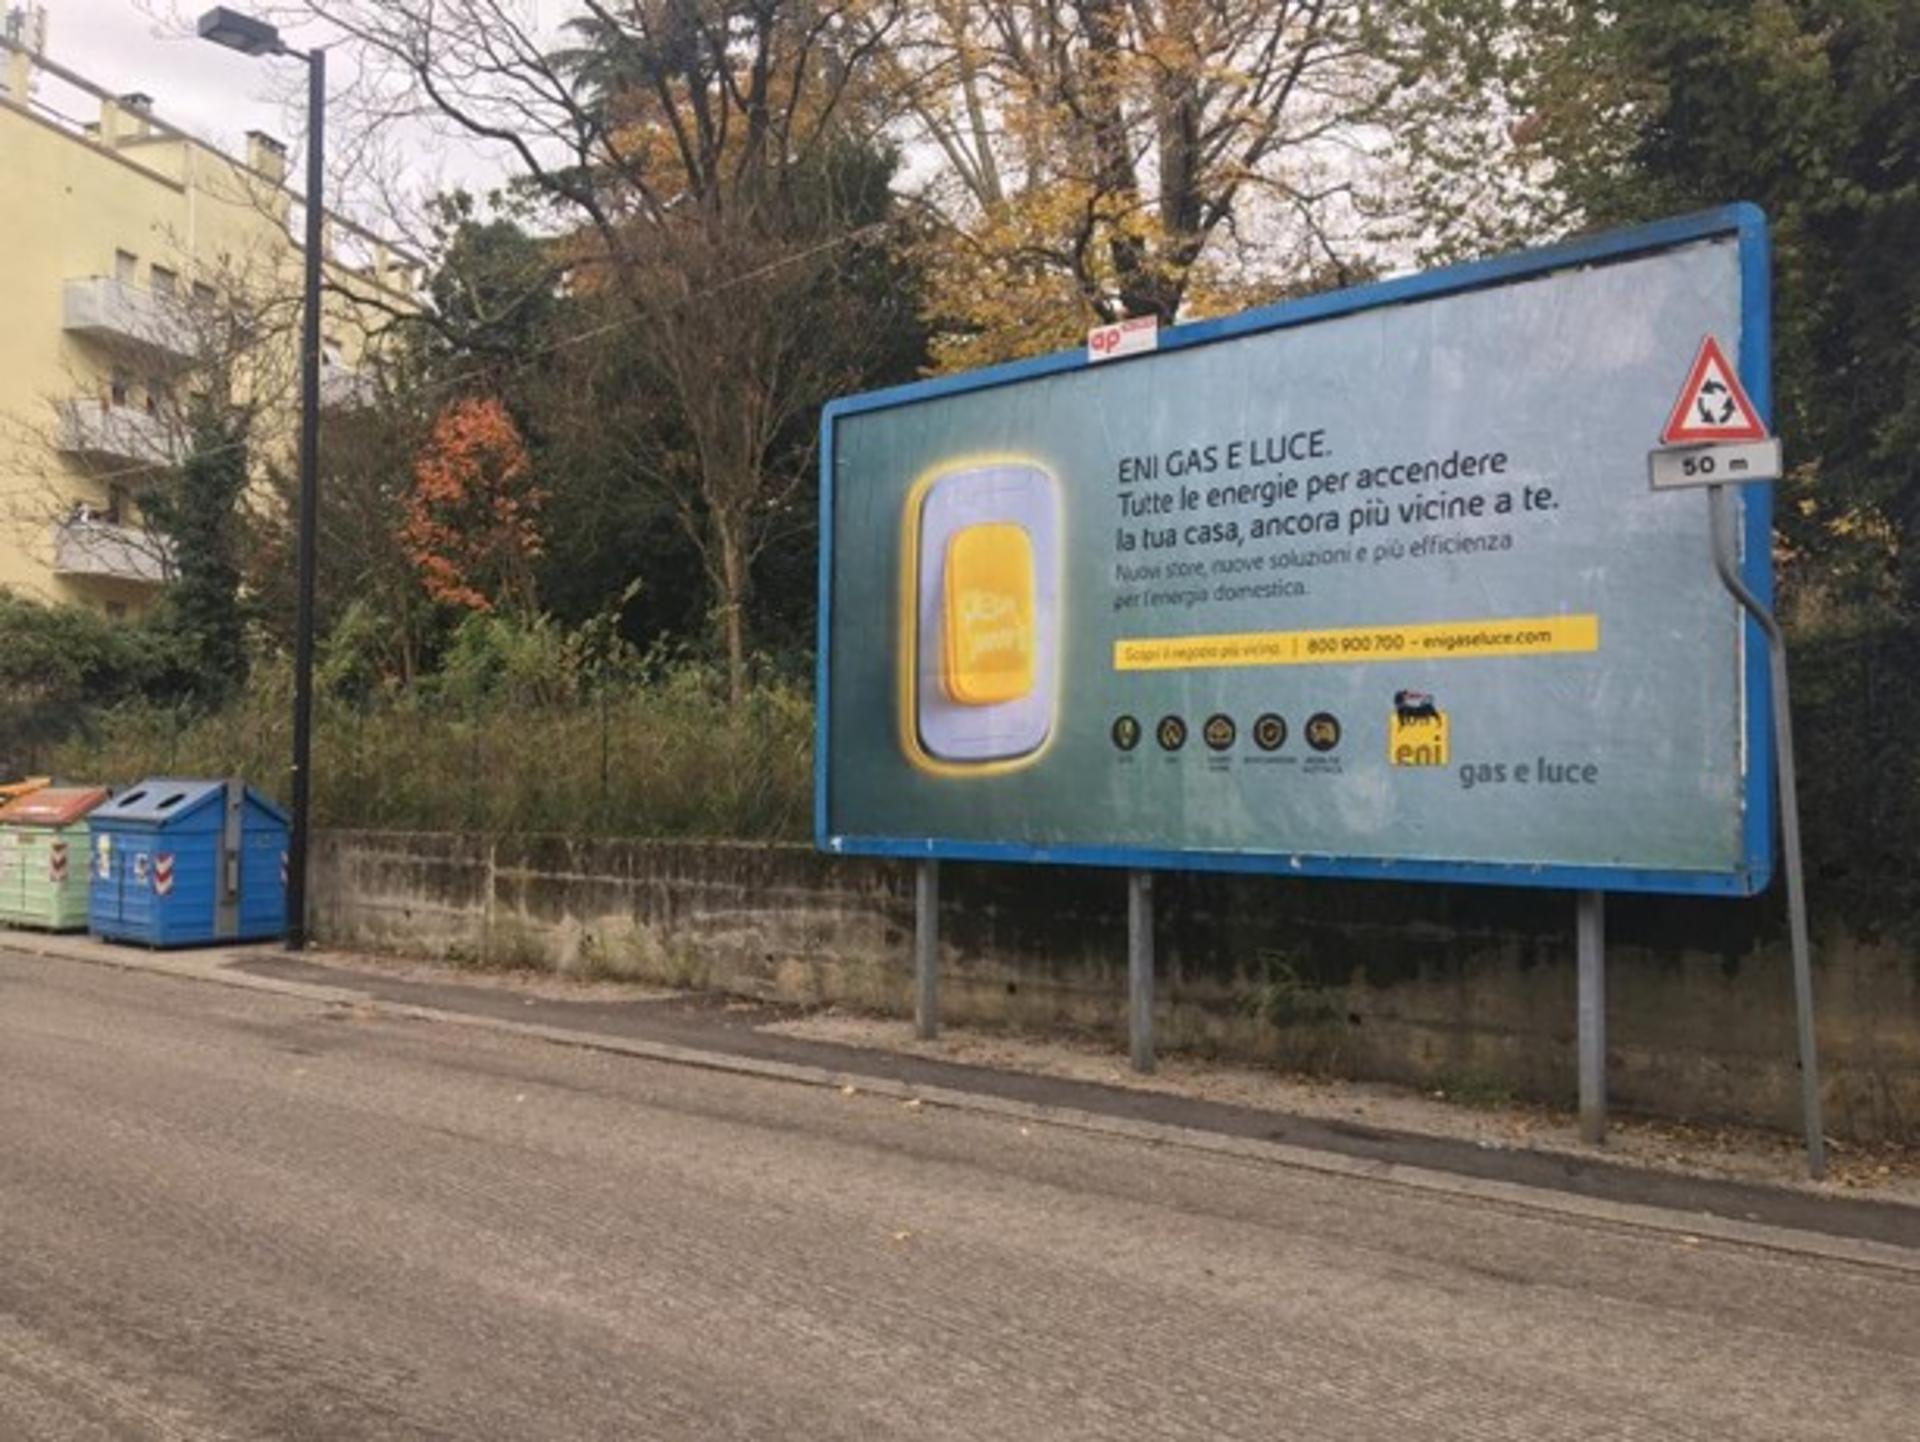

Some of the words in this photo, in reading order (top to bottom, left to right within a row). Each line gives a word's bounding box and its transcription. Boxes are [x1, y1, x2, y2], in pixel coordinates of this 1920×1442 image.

[1118, 455, 1158, 483] ENI
[1165, 446, 1219, 477] GAS
[1227, 441, 1243, 469] E
[1250, 429, 1333, 466] LUCE.
[1682, 456, 1715, 476] 50
[1117, 491, 1173, 517] Tutte
[1180, 485, 1199, 511] le
[1206, 471, 1298, 507] energie
[1306, 472, 1350, 501] per
[1356, 450, 1508, 489] accendere
[1116, 527, 1136, 552] la
[1143, 528, 1177, 549] tua
[1184, 522, 1245, 547] casa,
[1250, 511, 1340, 539] ancora
[1349, 498, 1390, 535] più
[1399, 490, 1485, 524] vicine
[1494, 492, 1512, 514] a
[1523, 485, 1559, 511] te.
[1212, 555, 1265, 574] nuove
[1269, 547, 1351, 570] soluzioni
[1356, 547, 1367, 562] e
[1373, 540, 1404, 565] più
[1410, 530, 1513, 557] efficienza
[1307, 639, 1337, 654] 800
[1341, 637, 1372, 652] 900
[1375, 635, 1404, 650] 700
[1422, 629, 1552, 650] enigaseluce.com
[1396, 735, 1442, 765] eni
[1459, 763, 1507, 789] gas
[1514, 765, 1530, 783] e
[1537, 757, 1599, 783] luce
